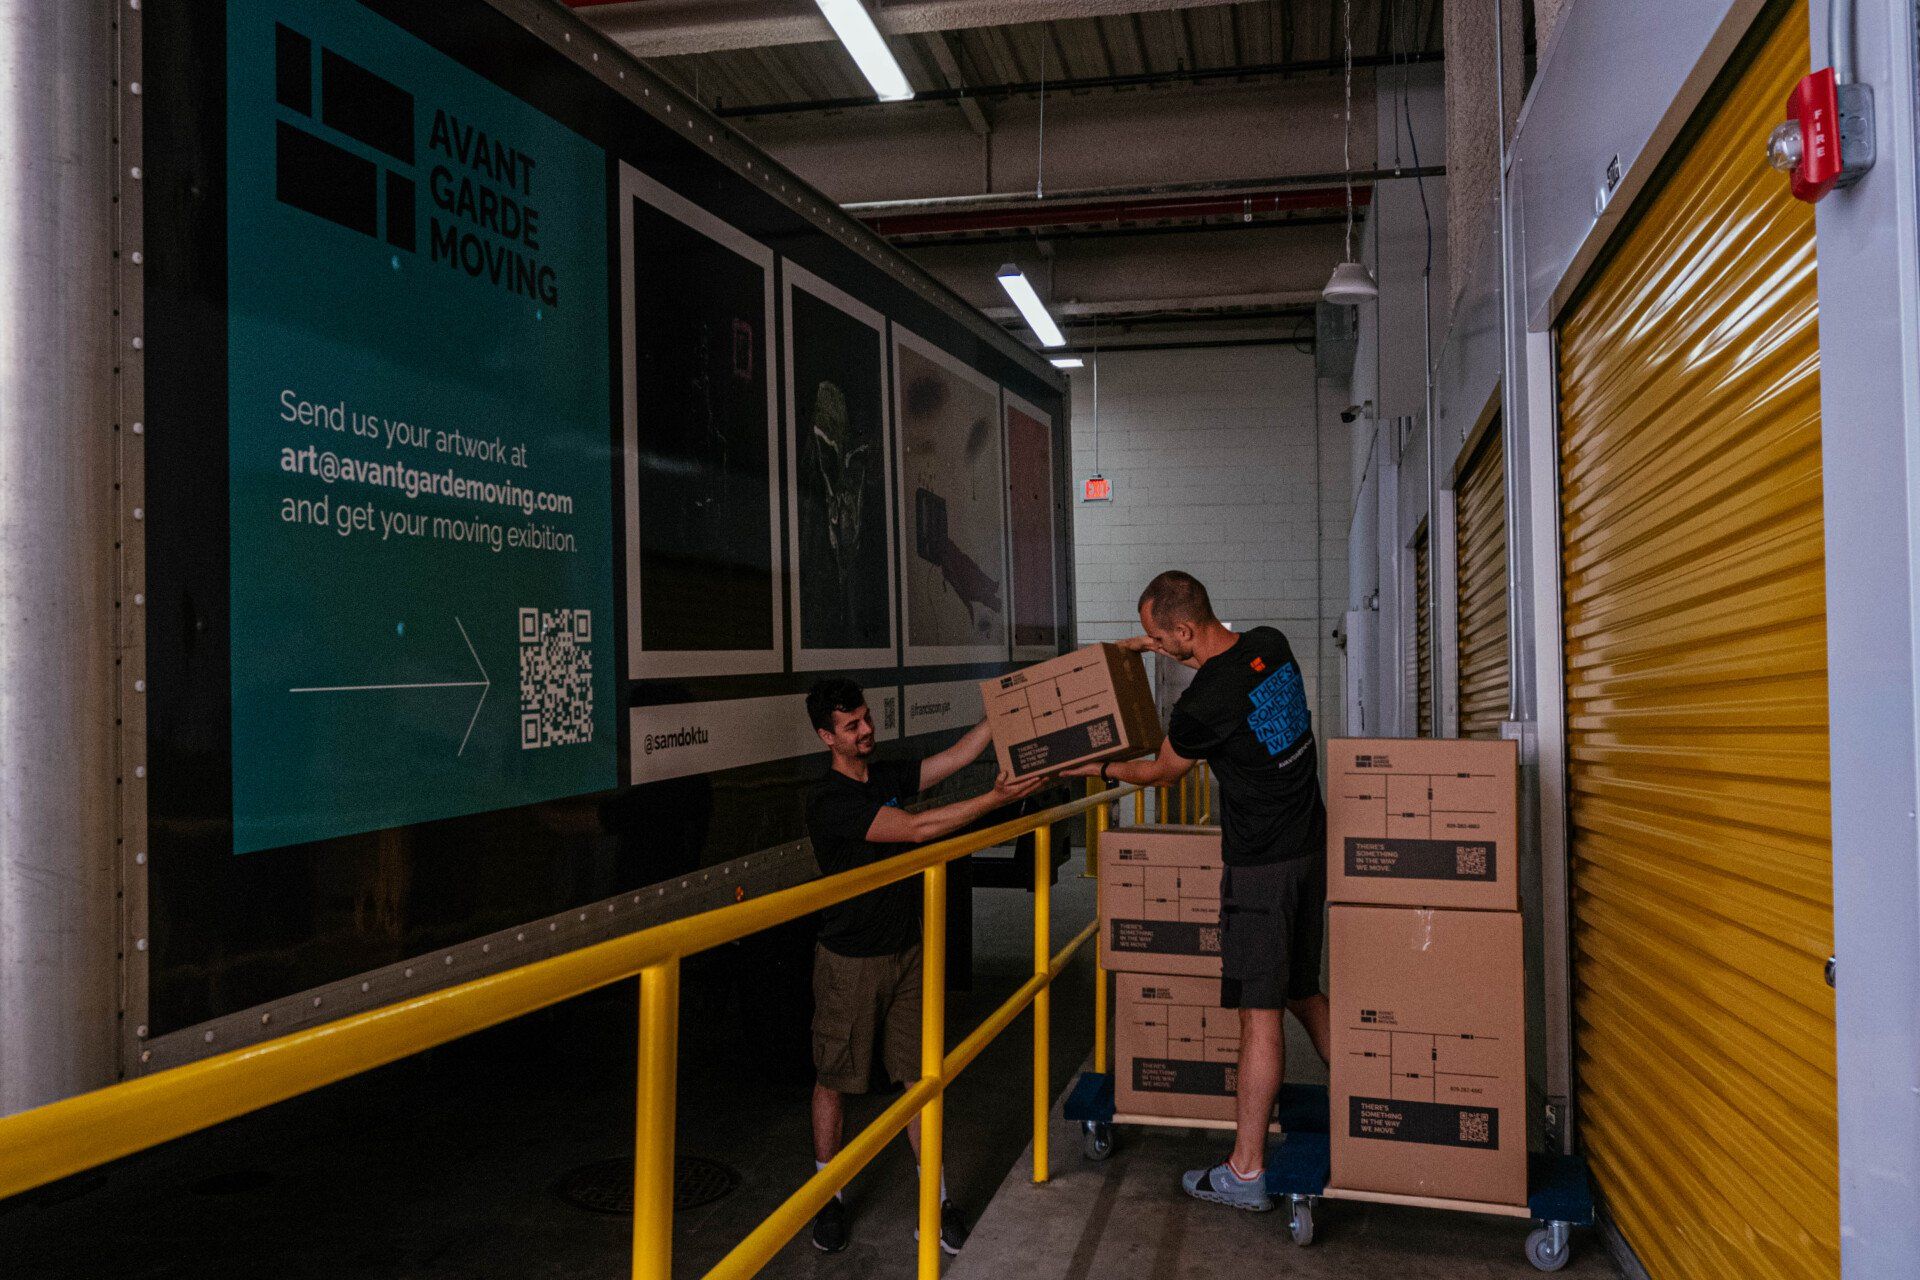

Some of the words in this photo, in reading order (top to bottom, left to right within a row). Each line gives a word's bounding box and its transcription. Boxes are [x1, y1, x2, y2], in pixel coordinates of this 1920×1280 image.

[429, 109, 536, 195] AVANT
[1813, 109, 1825, 157] FIRE
[429, 164, 540, 250] GARDE
[430, 217, 558, 308] MOVING
[280, 389, 345, 432] Send
[352, 411, 379, 438] us
[384, 419, 431, 449] your
[436, 429, 507, 464] artwork
[511, 443, 528, 468] at
[280, 445, 573, 515] art@avantgardemoving.com
[281, 495, 329, 525] and
[336, 501, 375, 536] get
[380, 510, 429, 540] your
[433, 515, 501, 552] moving
[507, 522, 578, 553] exibition.
[1251, 666, 1292, 703] THERE'S
[644, 728, 709, 755] @samdoktu
[1356, 850, 1398, 858] SOMETHING
[1361, 1102, 1390, 1111] THERE'S
[1361, 1110, 1403, 1120] SOMETHING
[1370, 1118, 1383, 1126] THE
[1384, 1120, 1401, 1128] WAY
